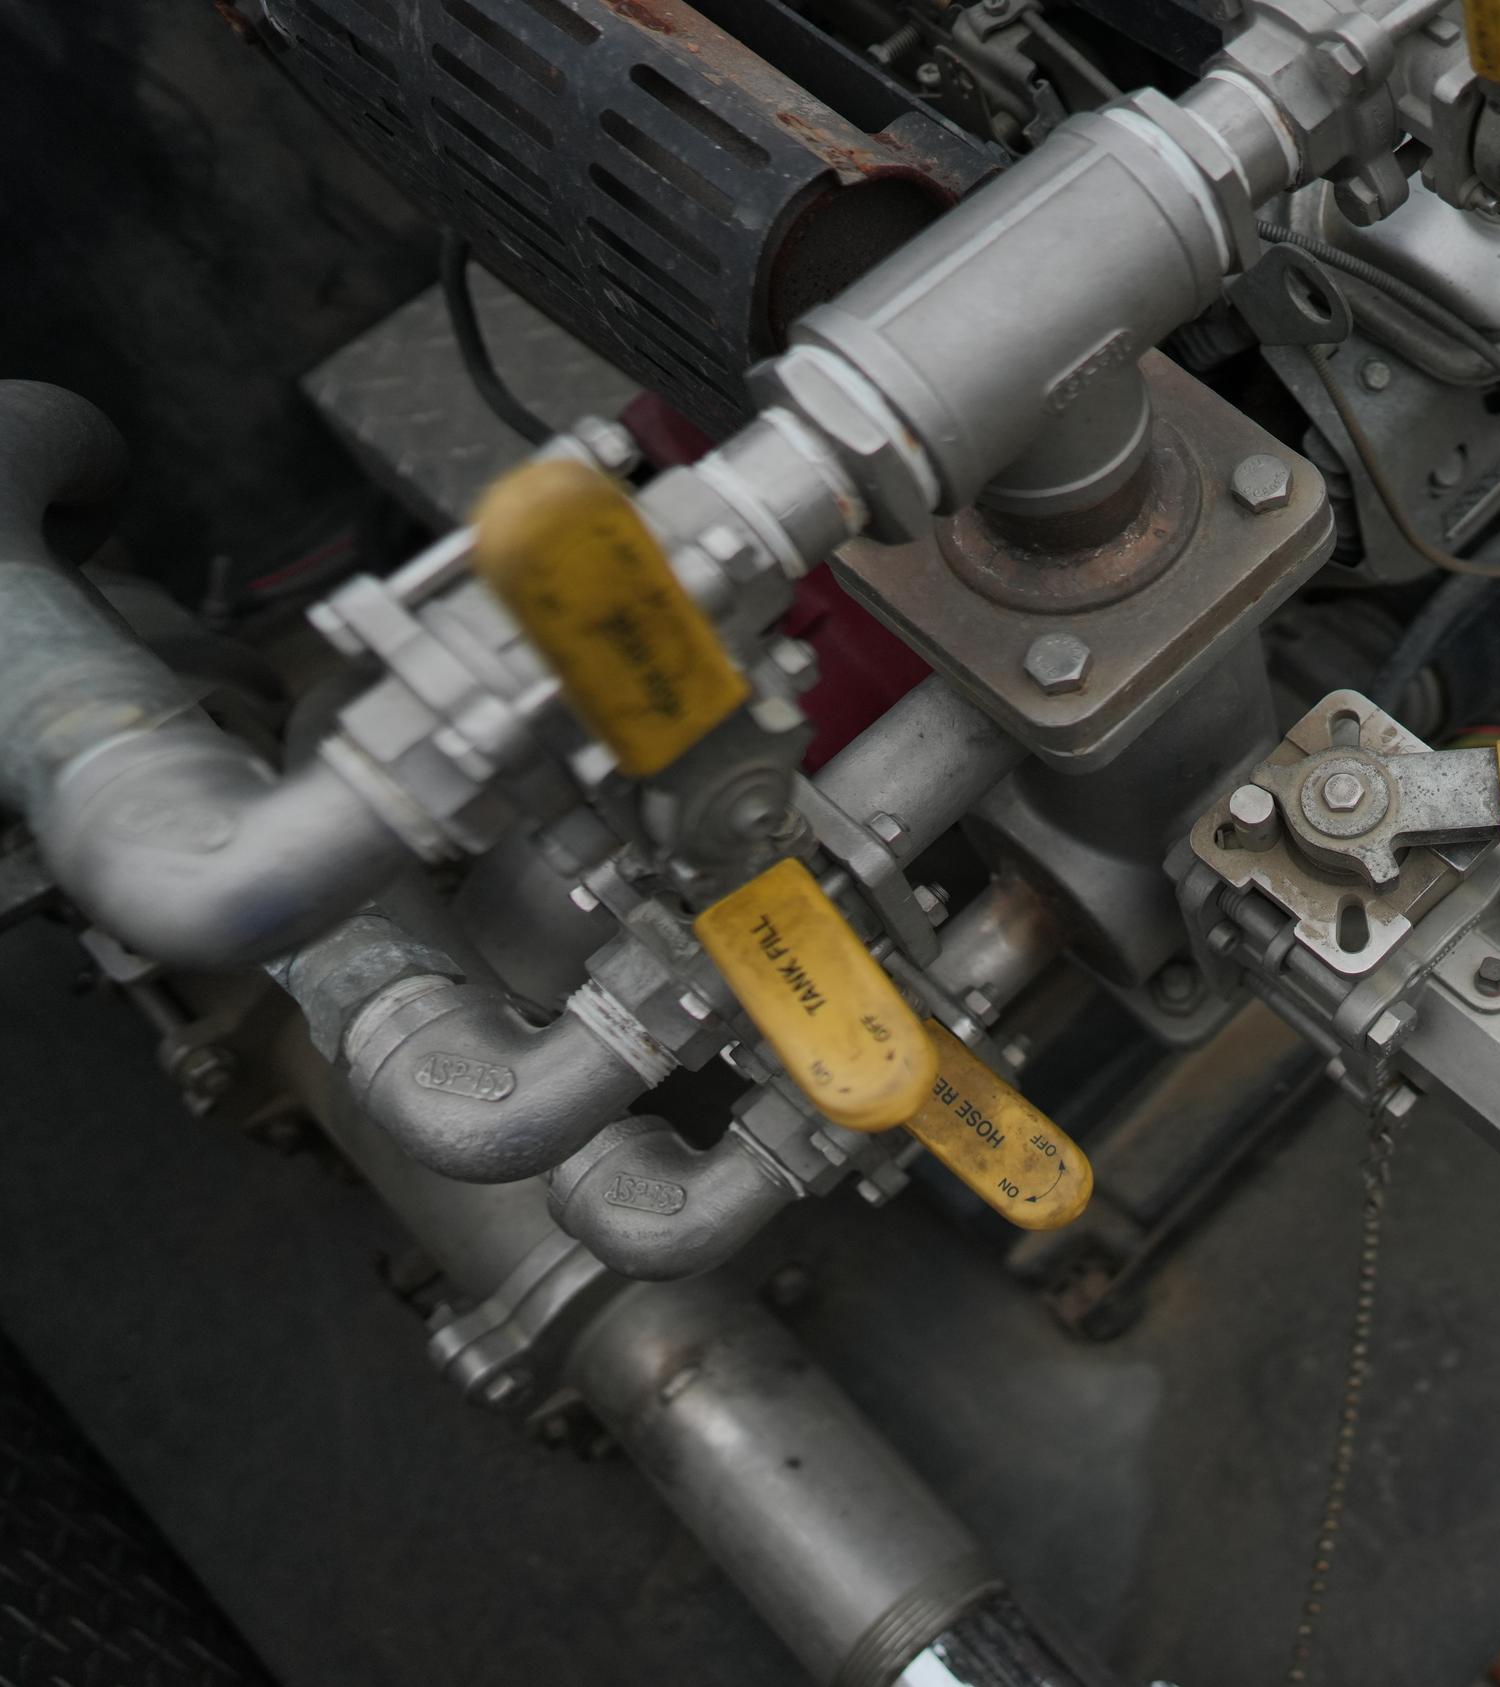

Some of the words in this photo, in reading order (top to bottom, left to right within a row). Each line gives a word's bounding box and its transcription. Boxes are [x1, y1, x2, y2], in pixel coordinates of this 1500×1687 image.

[750, 913, 790, 961] FILL
[777, 957, 829, 1017] TANK
[860, 1015, 892, 1043] OFF
[955, 1100, 1006, 1149] HOSE
[1030, 1134, 1057, 1157] OFF
[998, 1177, 1020, 1199] ON
